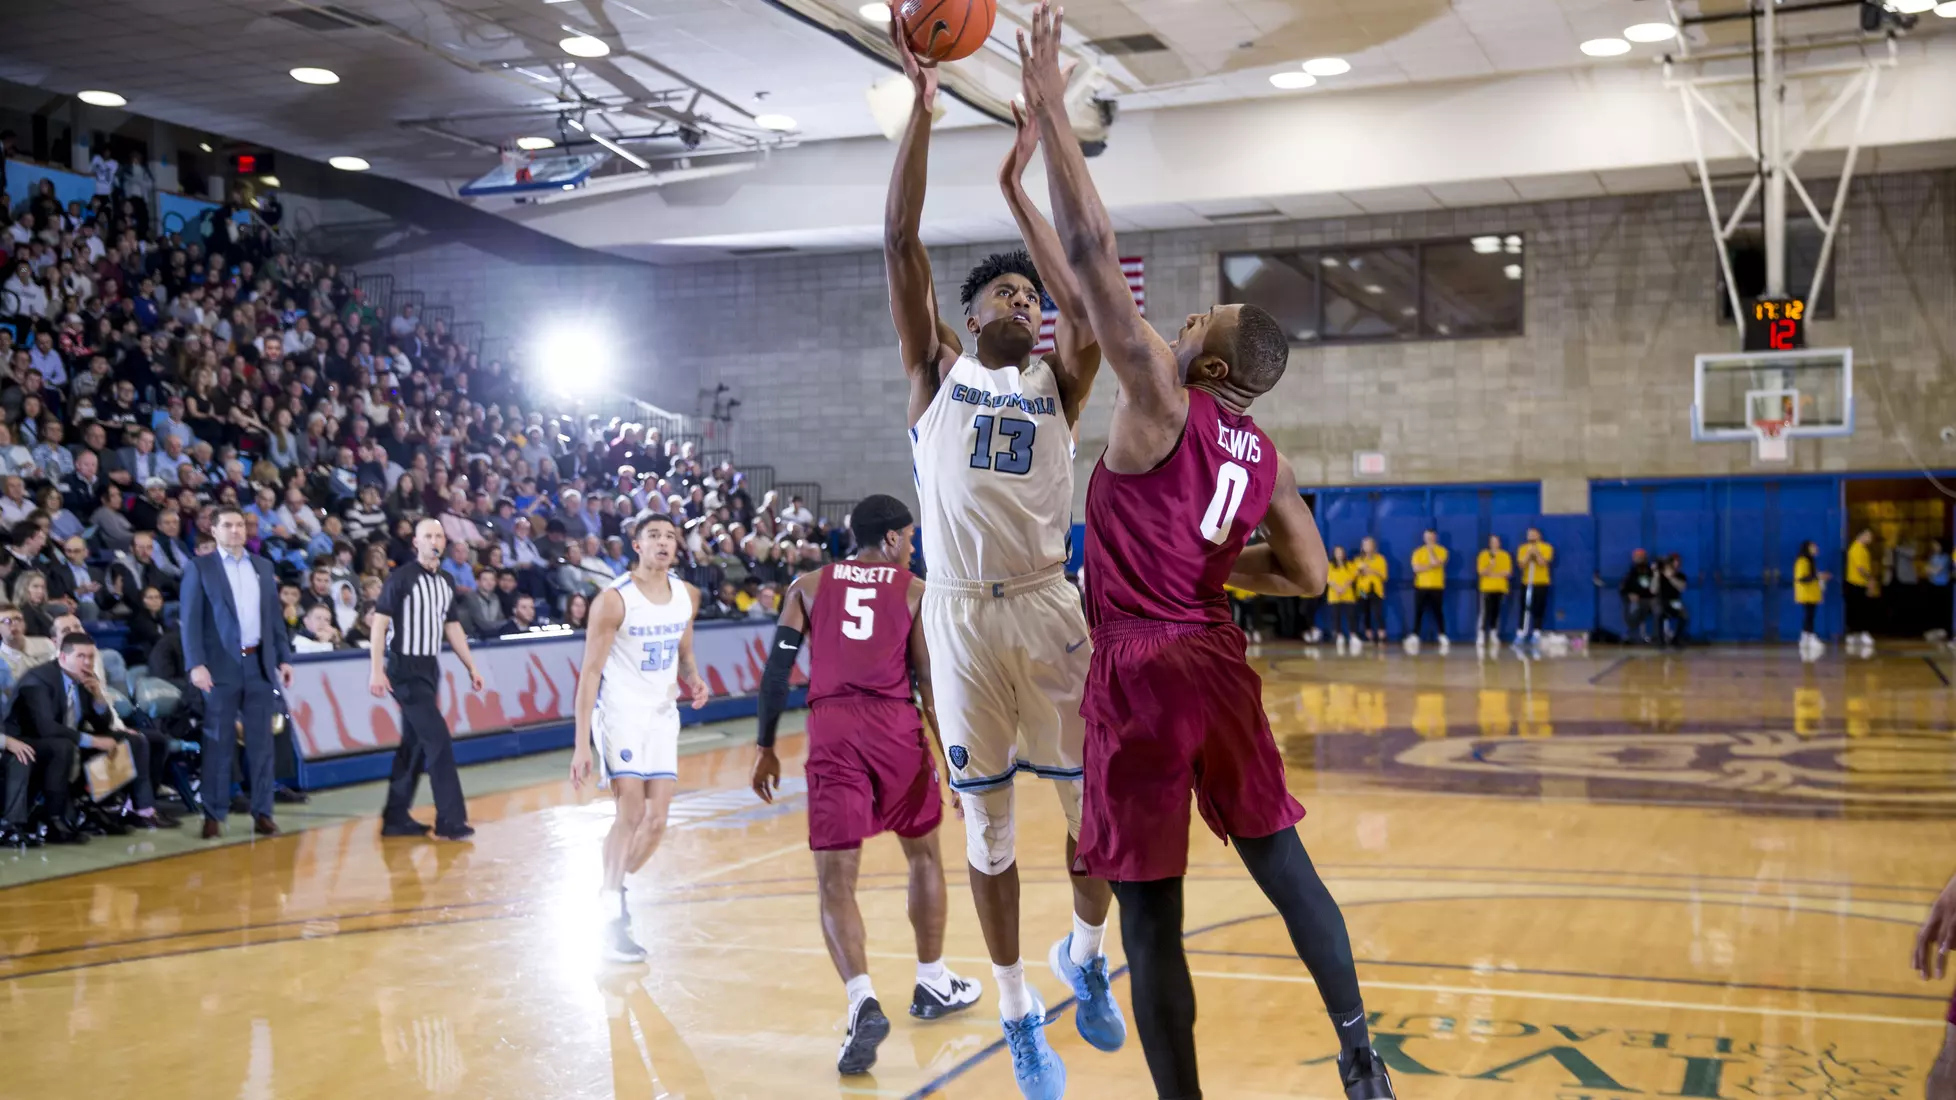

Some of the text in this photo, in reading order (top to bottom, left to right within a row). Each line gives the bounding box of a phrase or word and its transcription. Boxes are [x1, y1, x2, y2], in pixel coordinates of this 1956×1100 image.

[1755, 300, 1804, 320] 17:12
[1769, 319, 1796, 350] 12
[951, 383, 1057, 416] COLUMBIA
[970, 414, 1036, 475] 13
[1200, 460, 1249, 546] 0
[832, 563, 899, 584] HASKETT
[841, 587, 877, 640] 5
